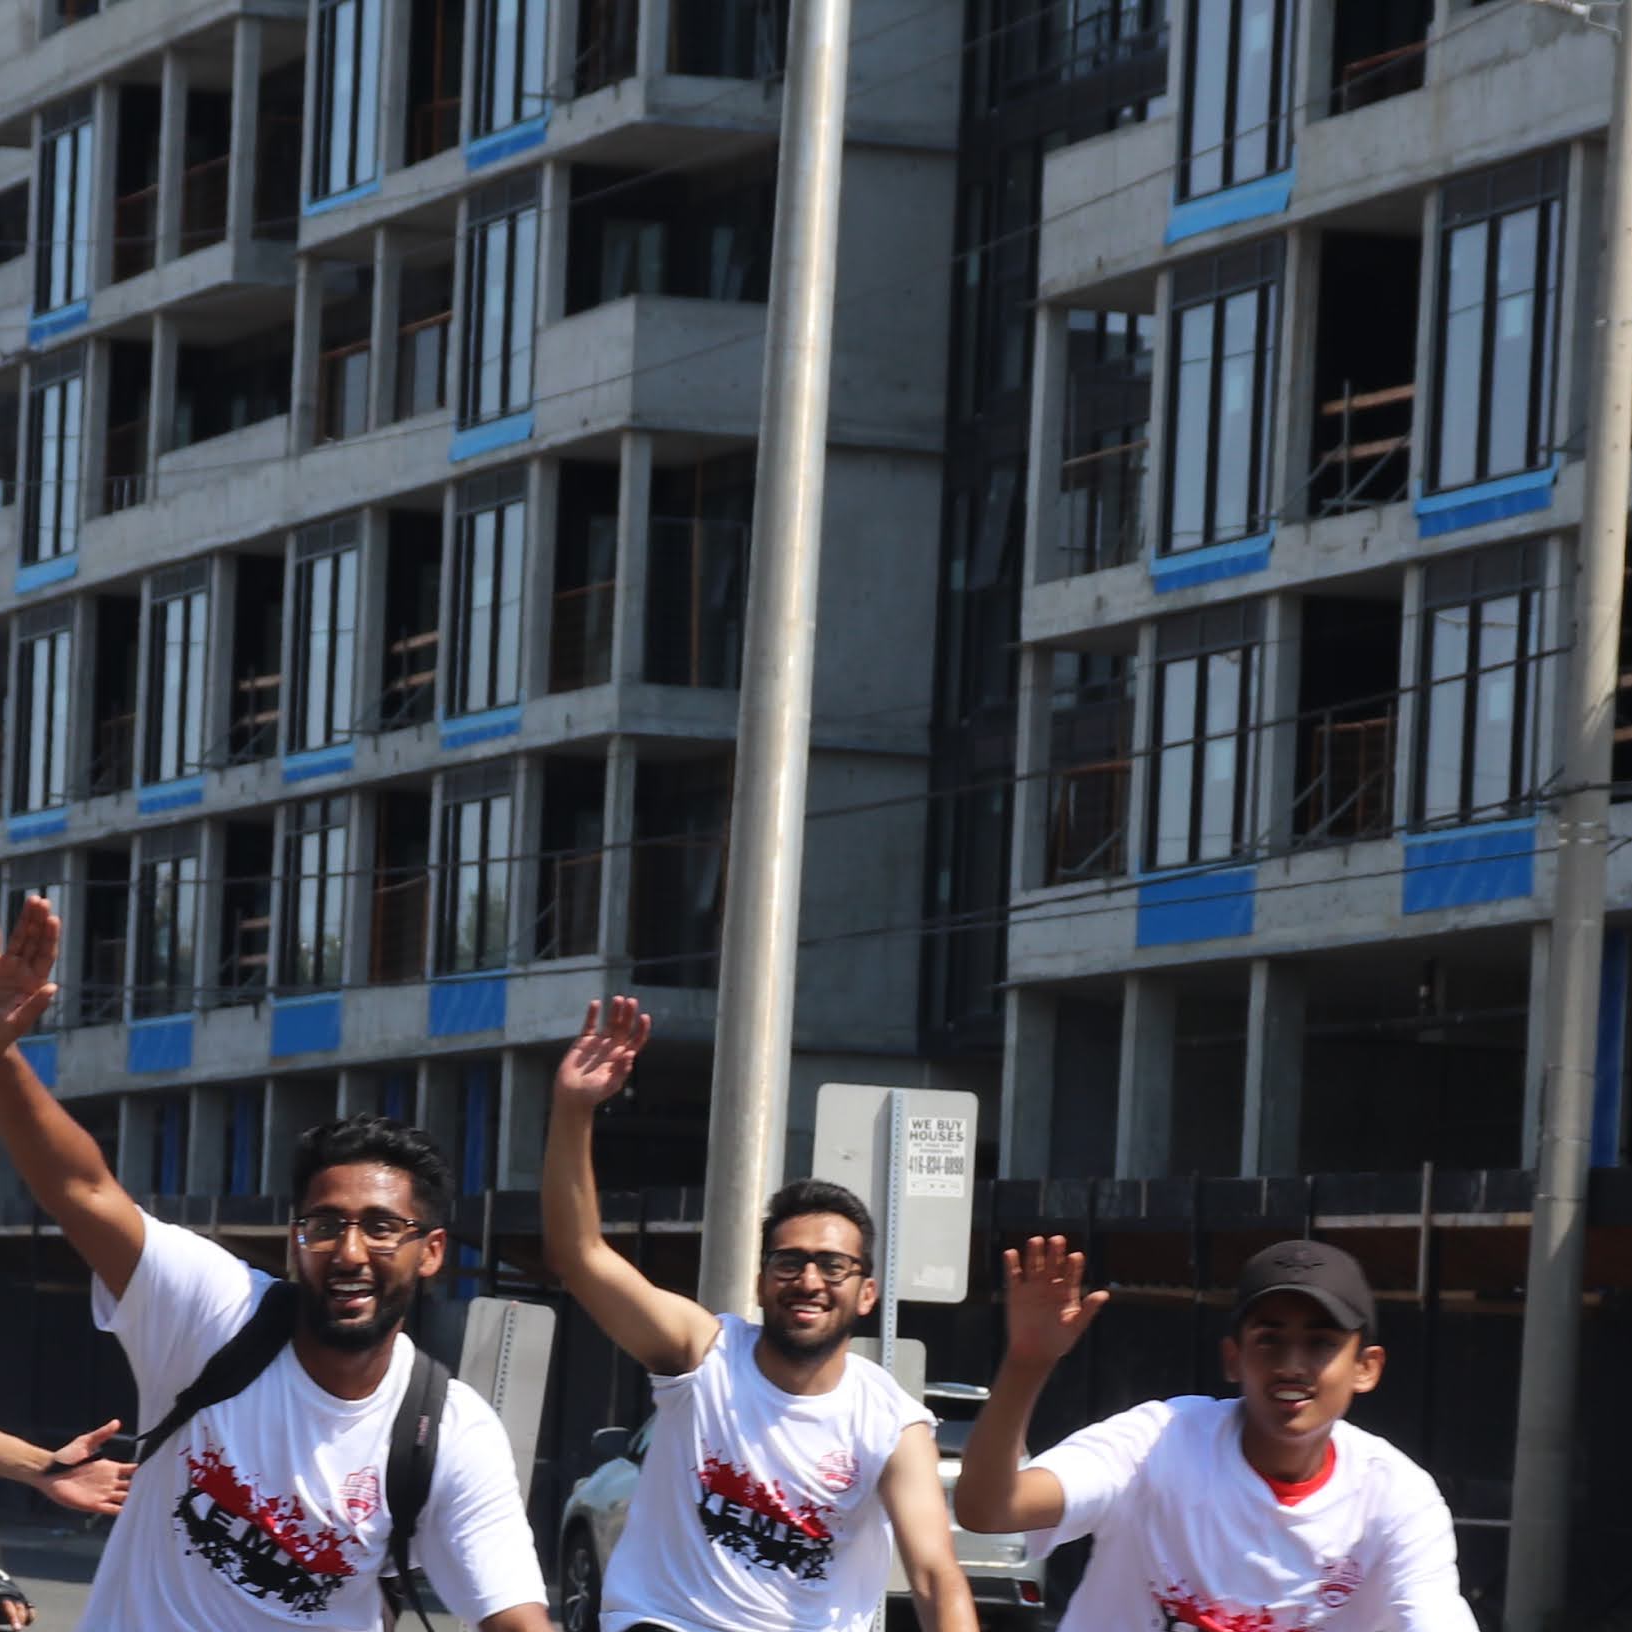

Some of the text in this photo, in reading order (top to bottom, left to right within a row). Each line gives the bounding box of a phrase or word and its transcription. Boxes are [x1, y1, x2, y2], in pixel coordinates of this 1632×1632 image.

[912, 1119, 962, 1131] WE BUY
[910, 1131, 964, 1142] HOUSES
